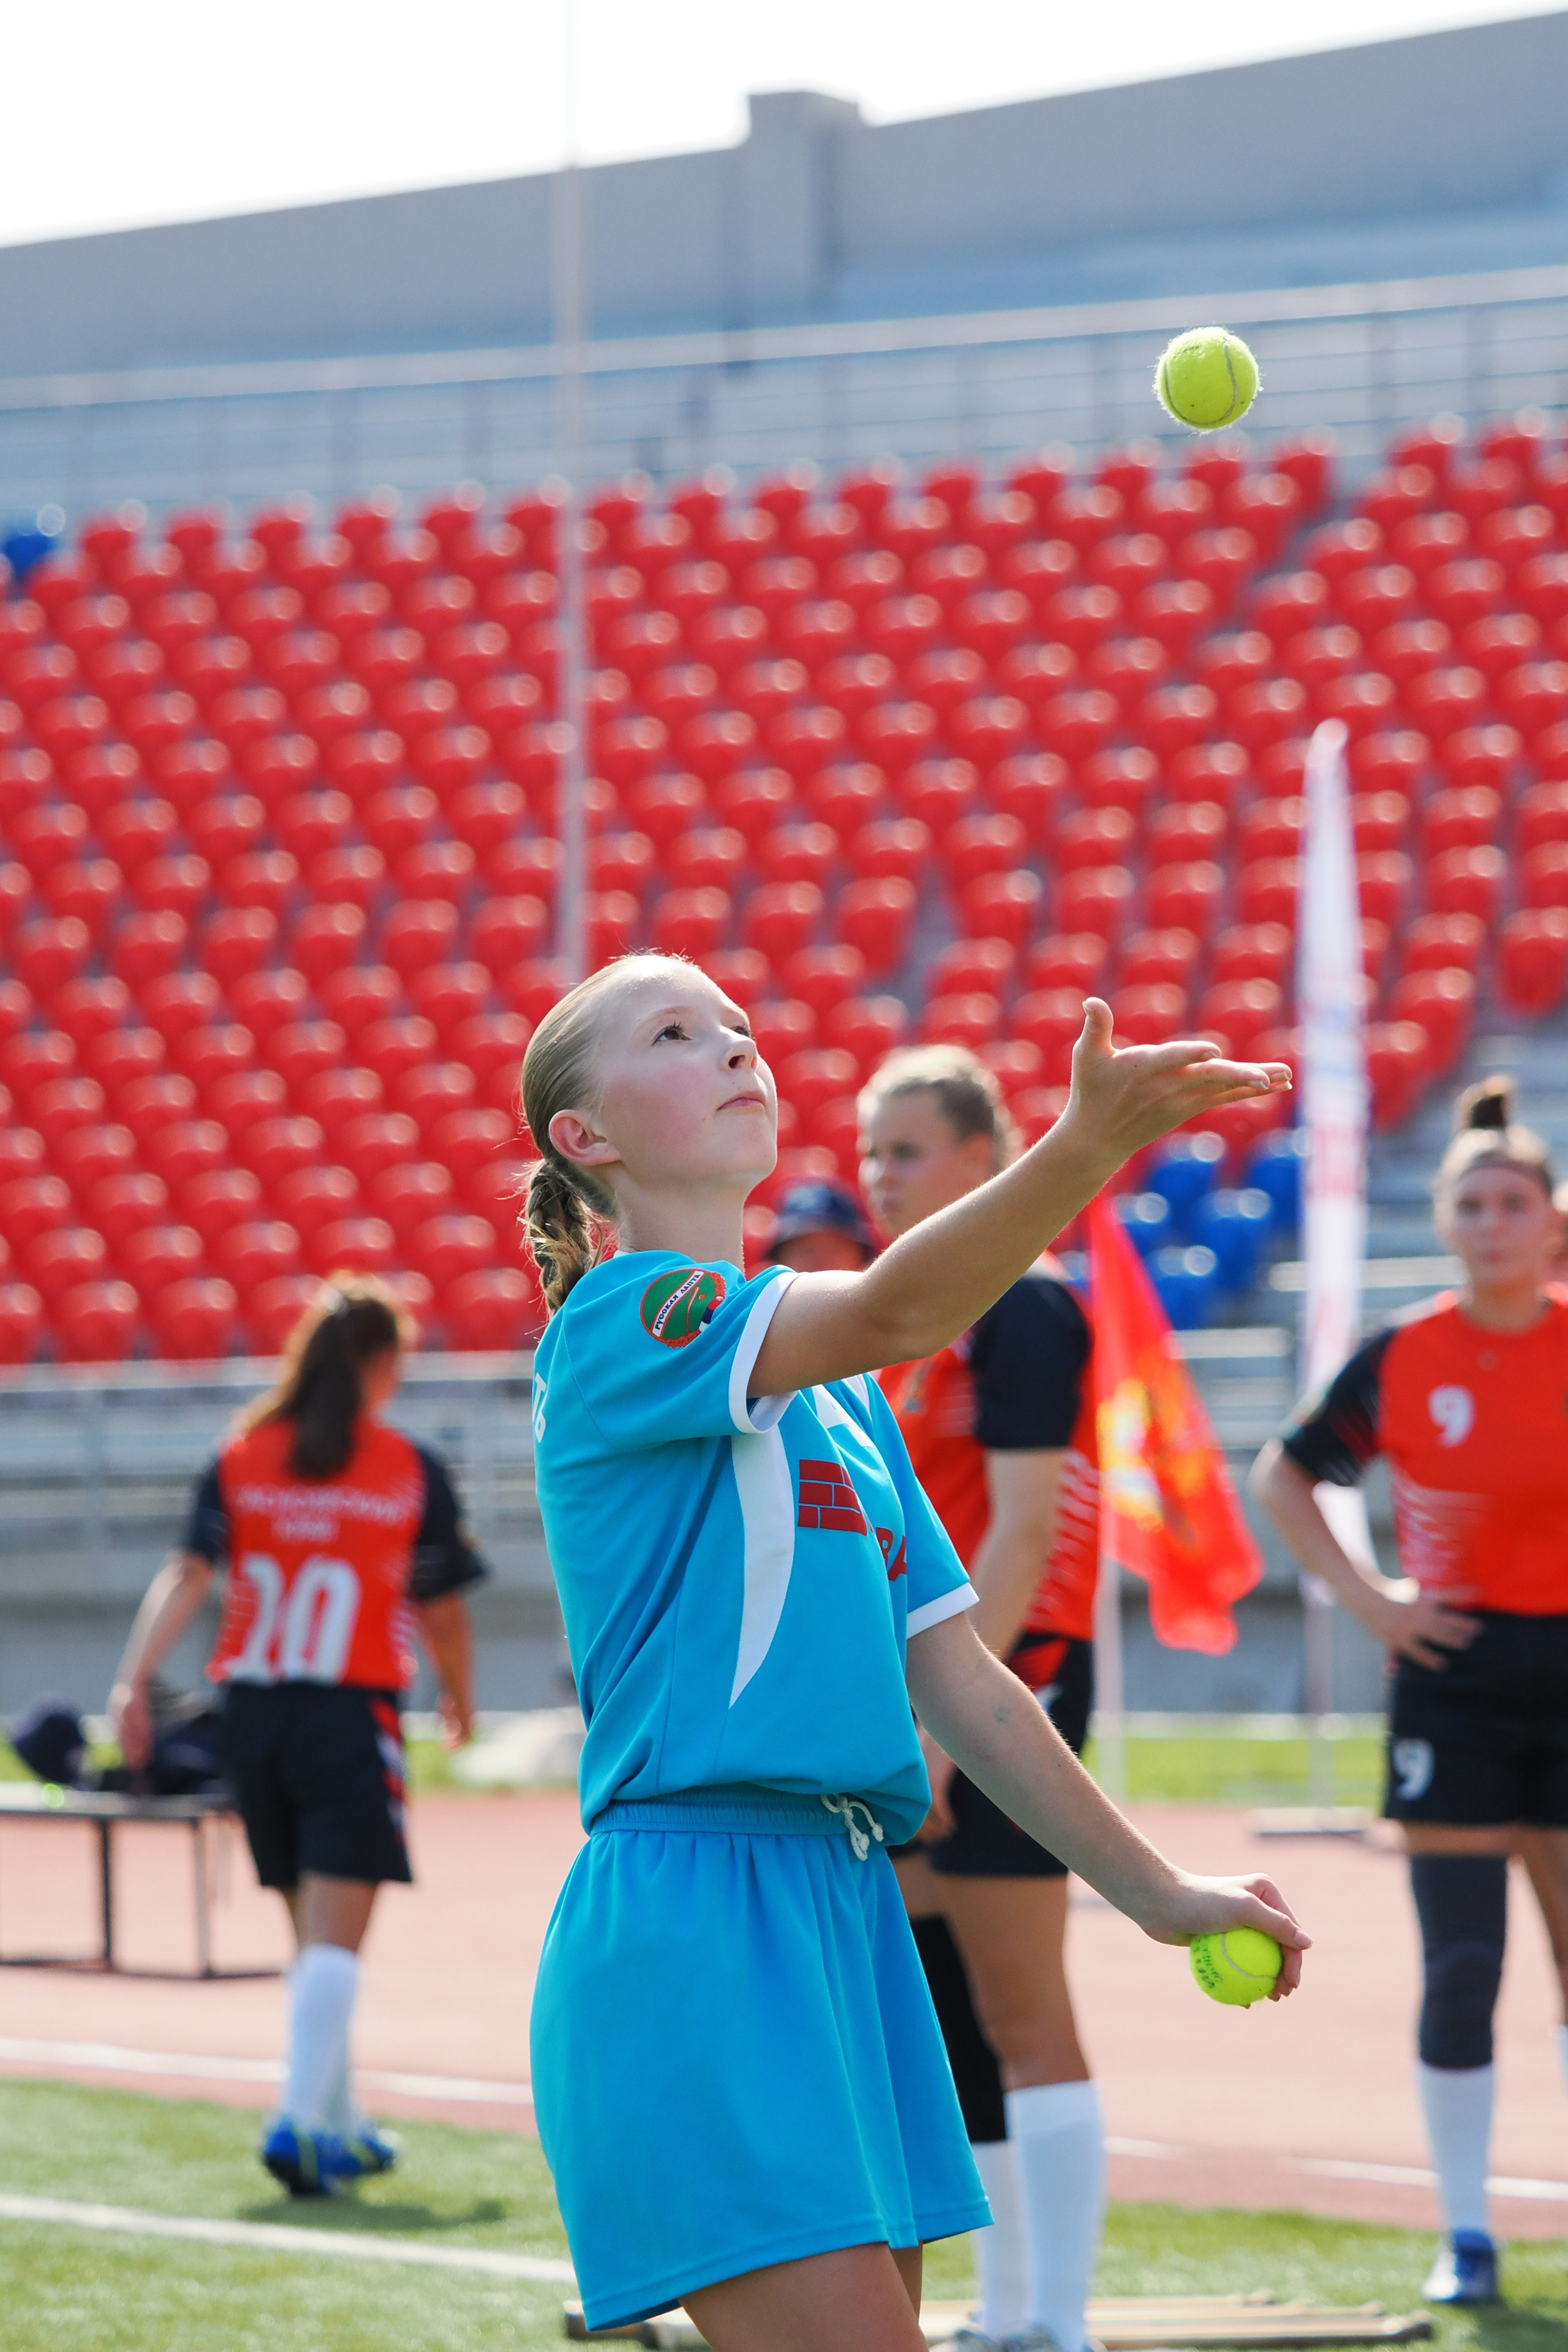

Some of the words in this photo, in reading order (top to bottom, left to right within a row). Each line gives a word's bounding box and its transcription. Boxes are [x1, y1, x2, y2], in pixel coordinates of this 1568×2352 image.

[680, 1274, 701, 1294] ЛАПТА
[1428, 1385, 1475, 1447] 9
[1393, 1738, 1435, 1801] 9
